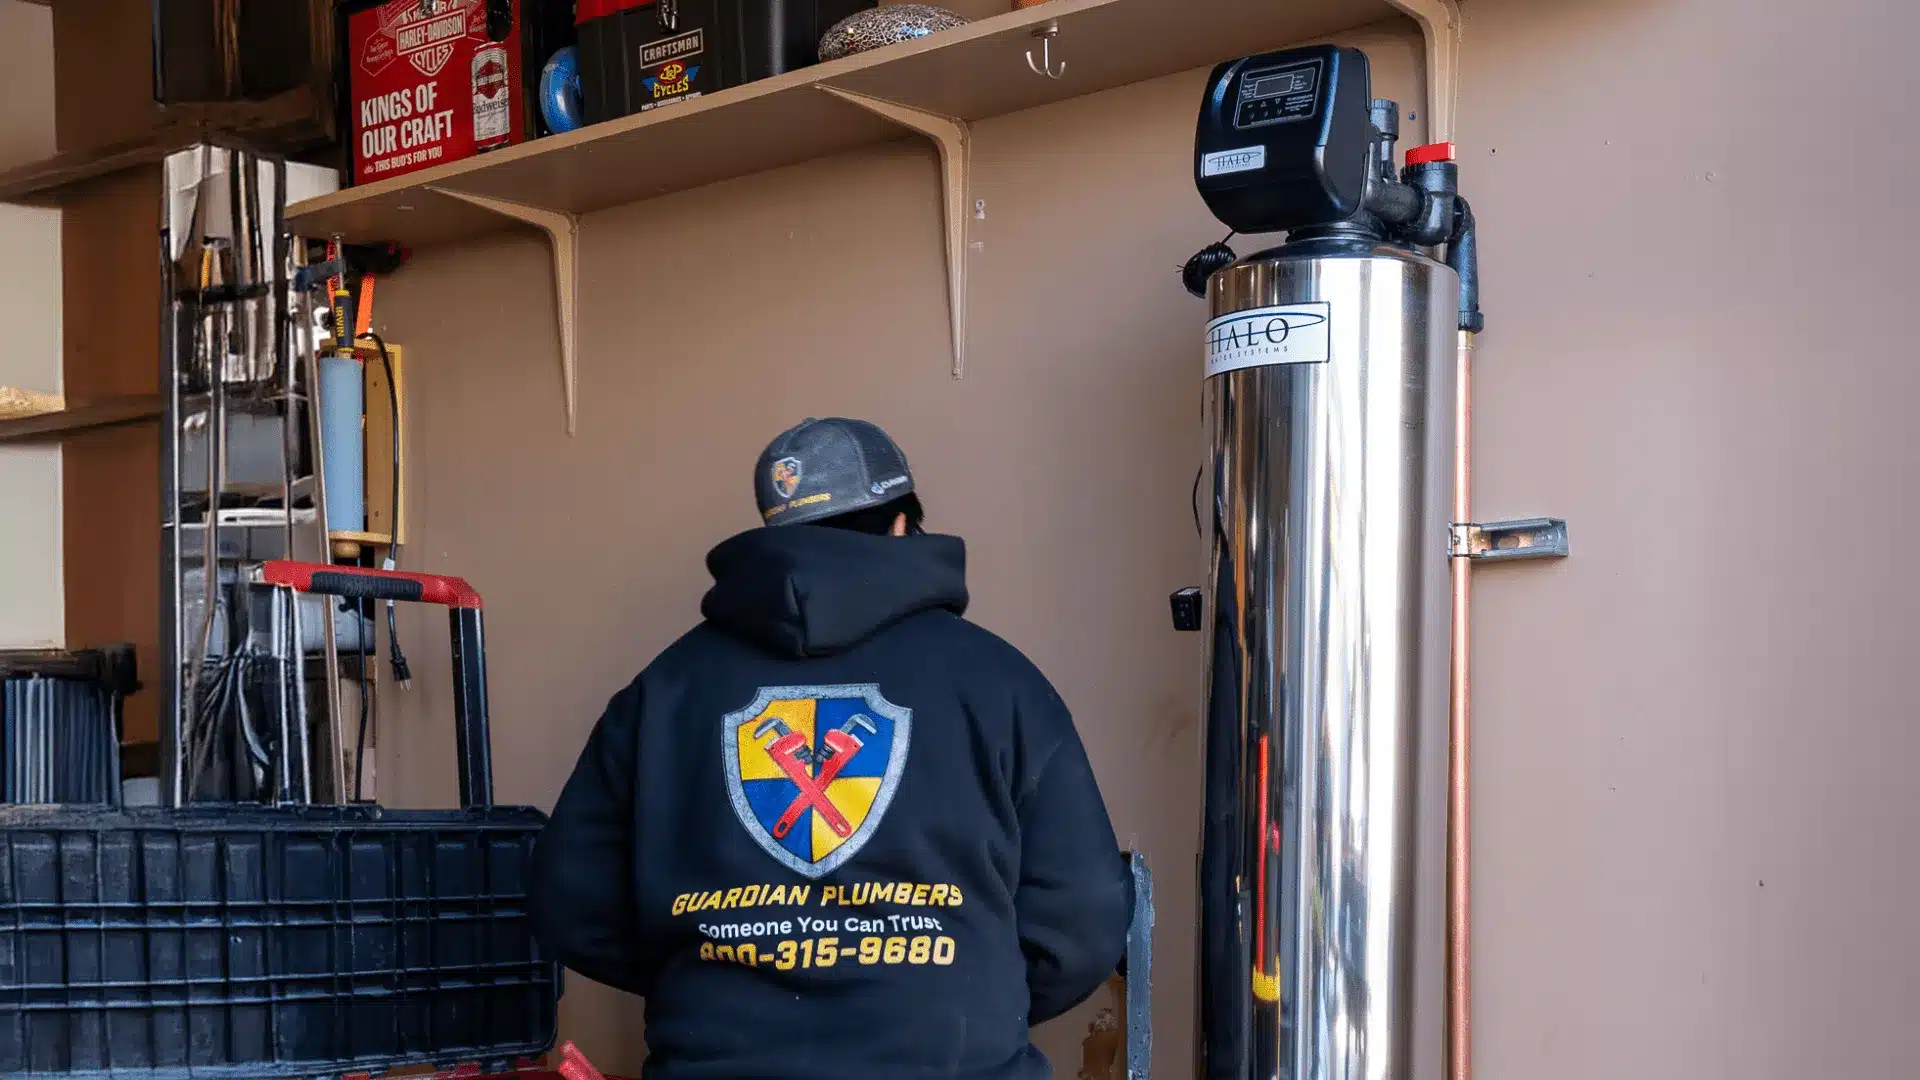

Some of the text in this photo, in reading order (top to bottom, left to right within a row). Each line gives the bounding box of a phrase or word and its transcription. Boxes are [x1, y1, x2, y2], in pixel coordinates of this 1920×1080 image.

[412, 1, 448, 22] MOR
[399, 15, 463, 50] HARLEY-DAVIDSON
[415, 44, 449, 72] CYCLES
[643, 35, 699, 62] CRAFTSMAN
[653, 74, 689, 98] CYCLES
[361, 81, 438, 128] KINGS OF
[362, 109, 454, 158] OUR CRAFT
[375, 145, 443, 173] THIS BUD'S FOR YOU
[1217, 154, 1251, 167] HALO
[335, 306, 345, 337] IRWIN
[1210, 317, 1289, 356] HALO
[1237, 345, 1289, 358] SYSTEMS
[671, 882, 964, 916] GUARDIAN PLUMBERS
[698, 914, 943, 939] Someone You Can Trust
